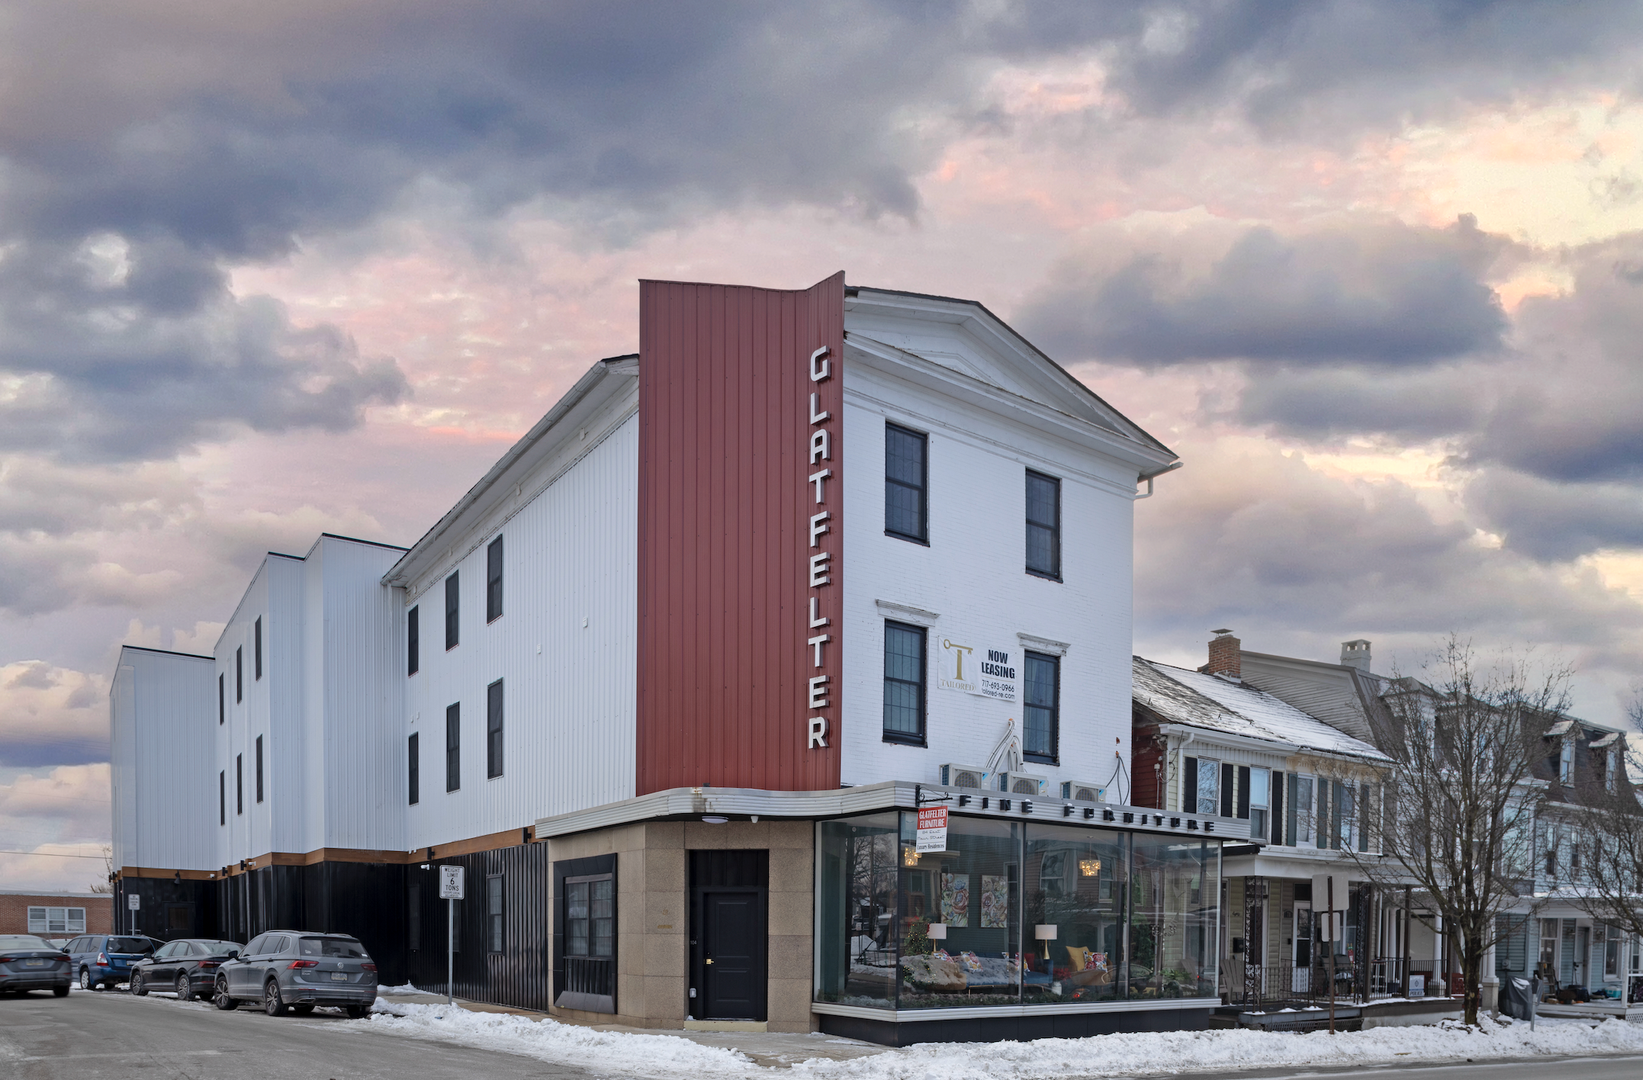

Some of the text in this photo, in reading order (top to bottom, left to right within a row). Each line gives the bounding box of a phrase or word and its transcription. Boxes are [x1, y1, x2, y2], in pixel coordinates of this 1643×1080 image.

[808, 345, 831, 749] GLATFELTER
[988, 649, 1008, 664] NOW
[981, 662, 1015, 679] LEASING
[940, 679, 976, 692] TAILORED
[981, 680, 1015, 692] 717-693-0966
[919, 809, 946, 819] GLATFELTER
[959, 794, 1215, 832] FINE FURNITURE
[919, 819, 944, 828] FURNITURE
